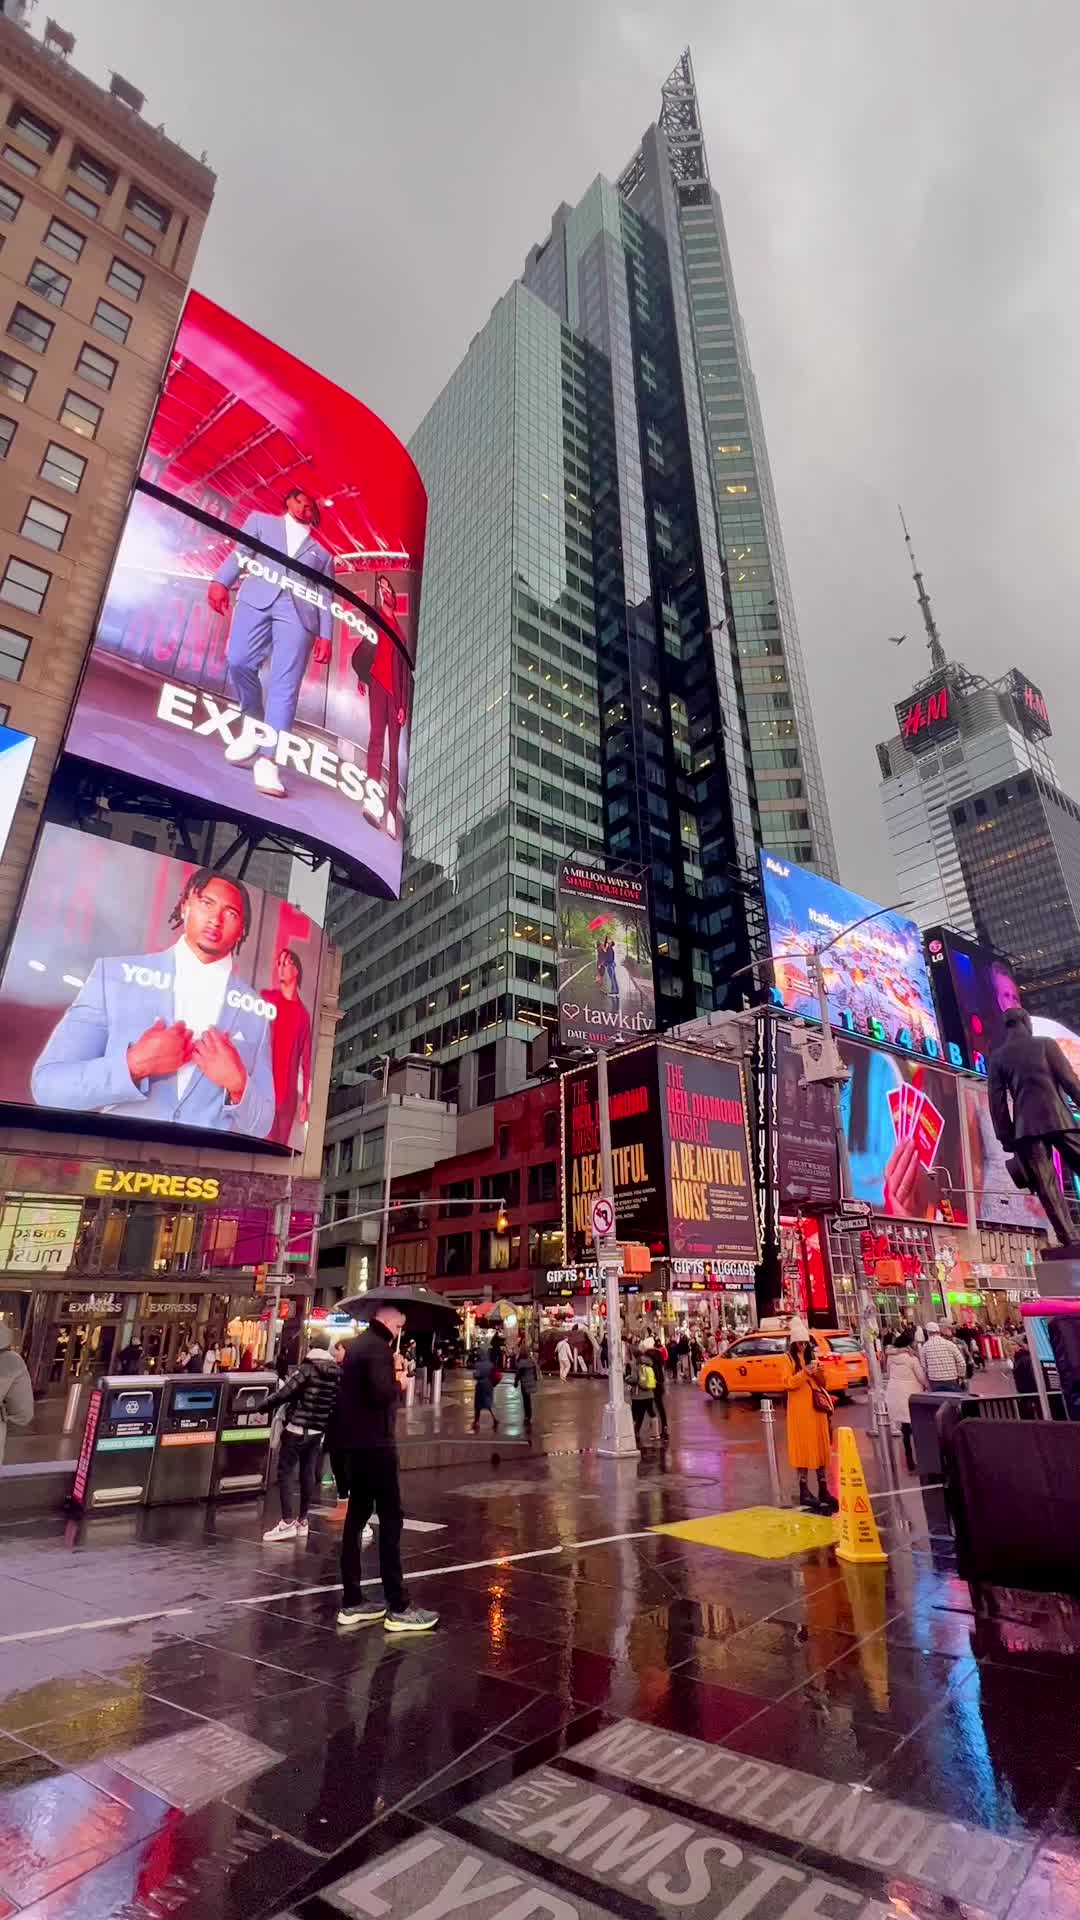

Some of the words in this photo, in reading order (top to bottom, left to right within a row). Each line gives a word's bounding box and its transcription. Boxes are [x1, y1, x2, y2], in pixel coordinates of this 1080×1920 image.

[234, 551, 279, 584] YOU
[281, 576, 327, 610] FEEL
[330, 602, 378, 644] GOOD
[157, 682, 385, 818] EXPRESS
[562, 866, 569, 875] A
[570, 868, 606, 884] MILLION
[607, 876, 629, 889] WAYS
[630, 880, 642, 892] TO
[565, 876, 594, 890] SHARE
[595, 882, 619, 896] YOUR
[619, 888, 641, 900] LOVE
[931, 953, 944, 963] LG
[121, 962, 171, 990] YOU
[226, 990, 277, 1020] GOOD
[567, 1029, 588, 1040] DATE
[665, 1062, 684, 1089] THE
[667, 1087, 688, 1115] NEIL
[692, 1093, 744, 1126] DIAMOND
[668, 1112, 710, 1144] MUSICAL
[572, 1158, 579, 1194] A
[582, 1143, 648, 1190] BEATIFUL
[671, 1140, 680, 1178] A
[681, 1144, 746, 1186] BEAUTIFUL
[95, 1169, 220, 1200] EXPRESS
[672, 1179, 711, 1222] NOISE
[836, 1221, 849, 1229] ONE
[852, 1219, 865, 1227] WAY
[546, 1269, 578, 1283] GIFTS
[674, 1260, 705, 1275] GIFTS
[711, 1261, 756, 1276] LUGGAGE
[68, 1302, 123, 1313] EXPRESS
[150, 1303, 198, 1313] EXPRESS
[481, 1772, 578, 1831] NEW
[584, 1723, 1018, 1895] NEDERLANDER
